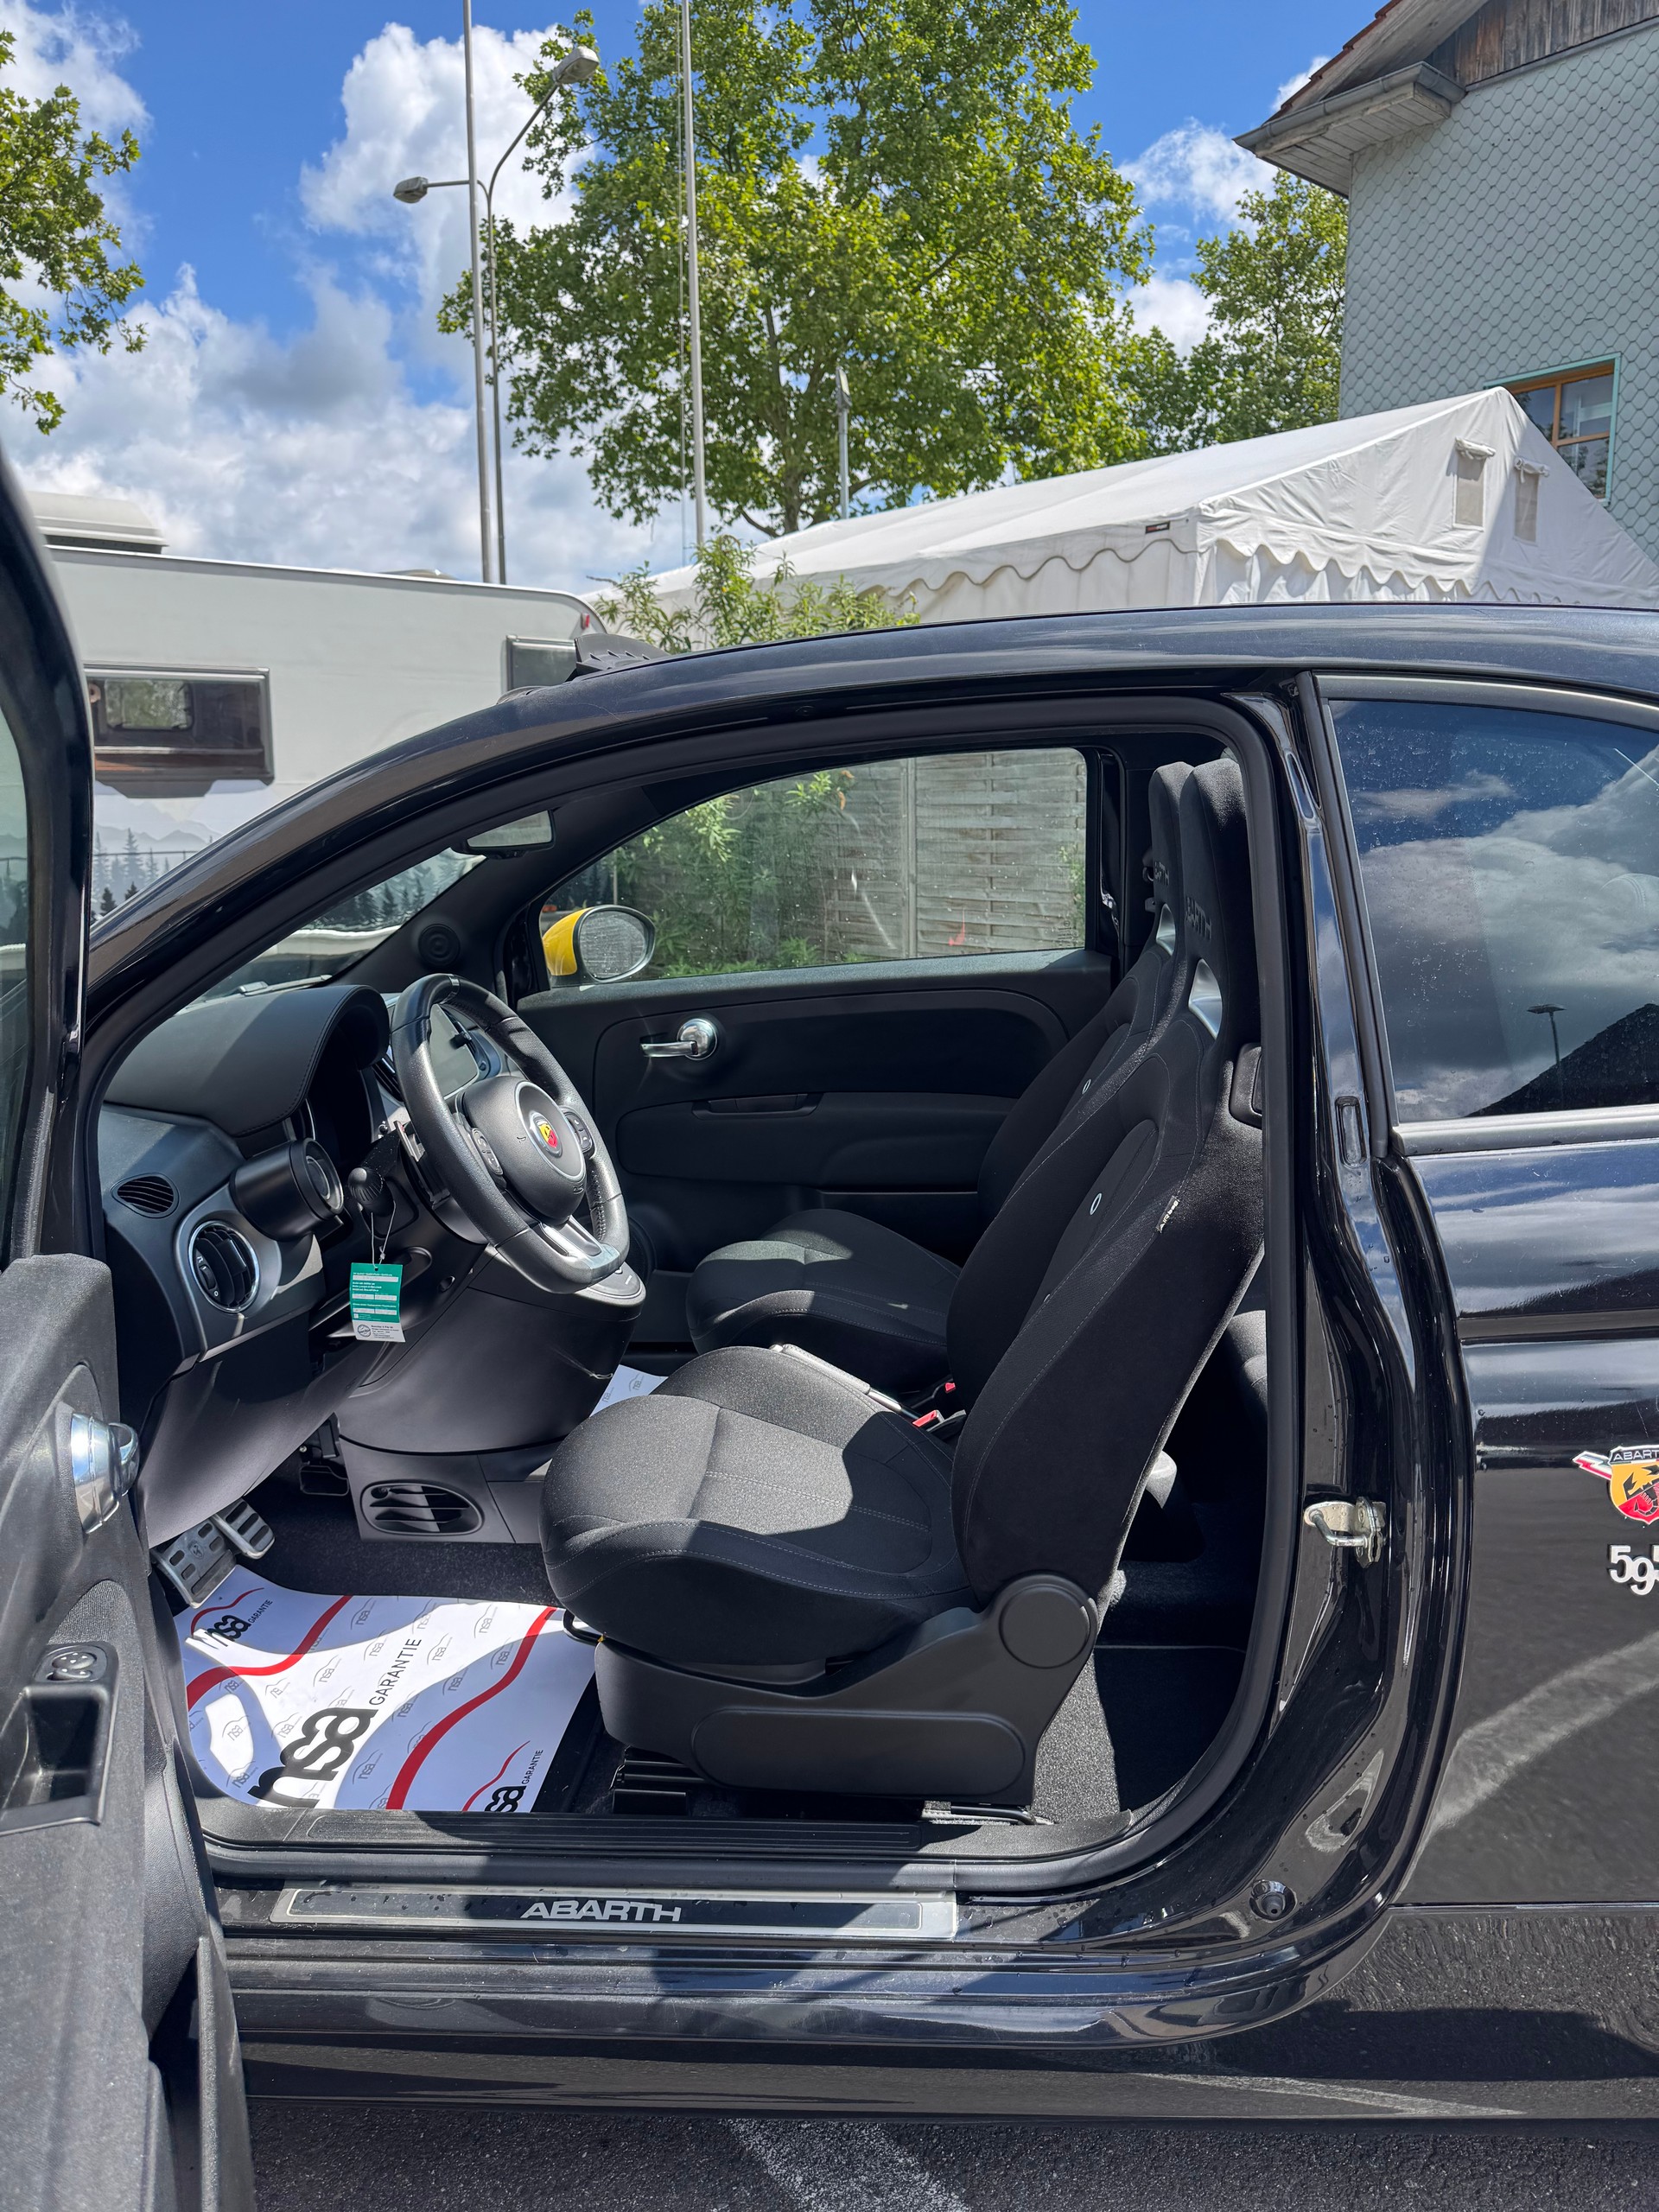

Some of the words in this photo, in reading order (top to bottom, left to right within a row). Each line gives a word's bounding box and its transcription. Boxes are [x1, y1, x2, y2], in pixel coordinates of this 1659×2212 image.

[1613, 1449, 1659, 1460] ABART
[248, 1599, 274, 1624] GARANTIE
[247, 1707, 378, 1808] nsa
[368, 1638, 423, 1706] GARANTIE
[484, 1785, 526, 1813] sa
[521, 1749, 543, 1784] GARANTIE
[520, 1899, 682, 1922] ABARTH
